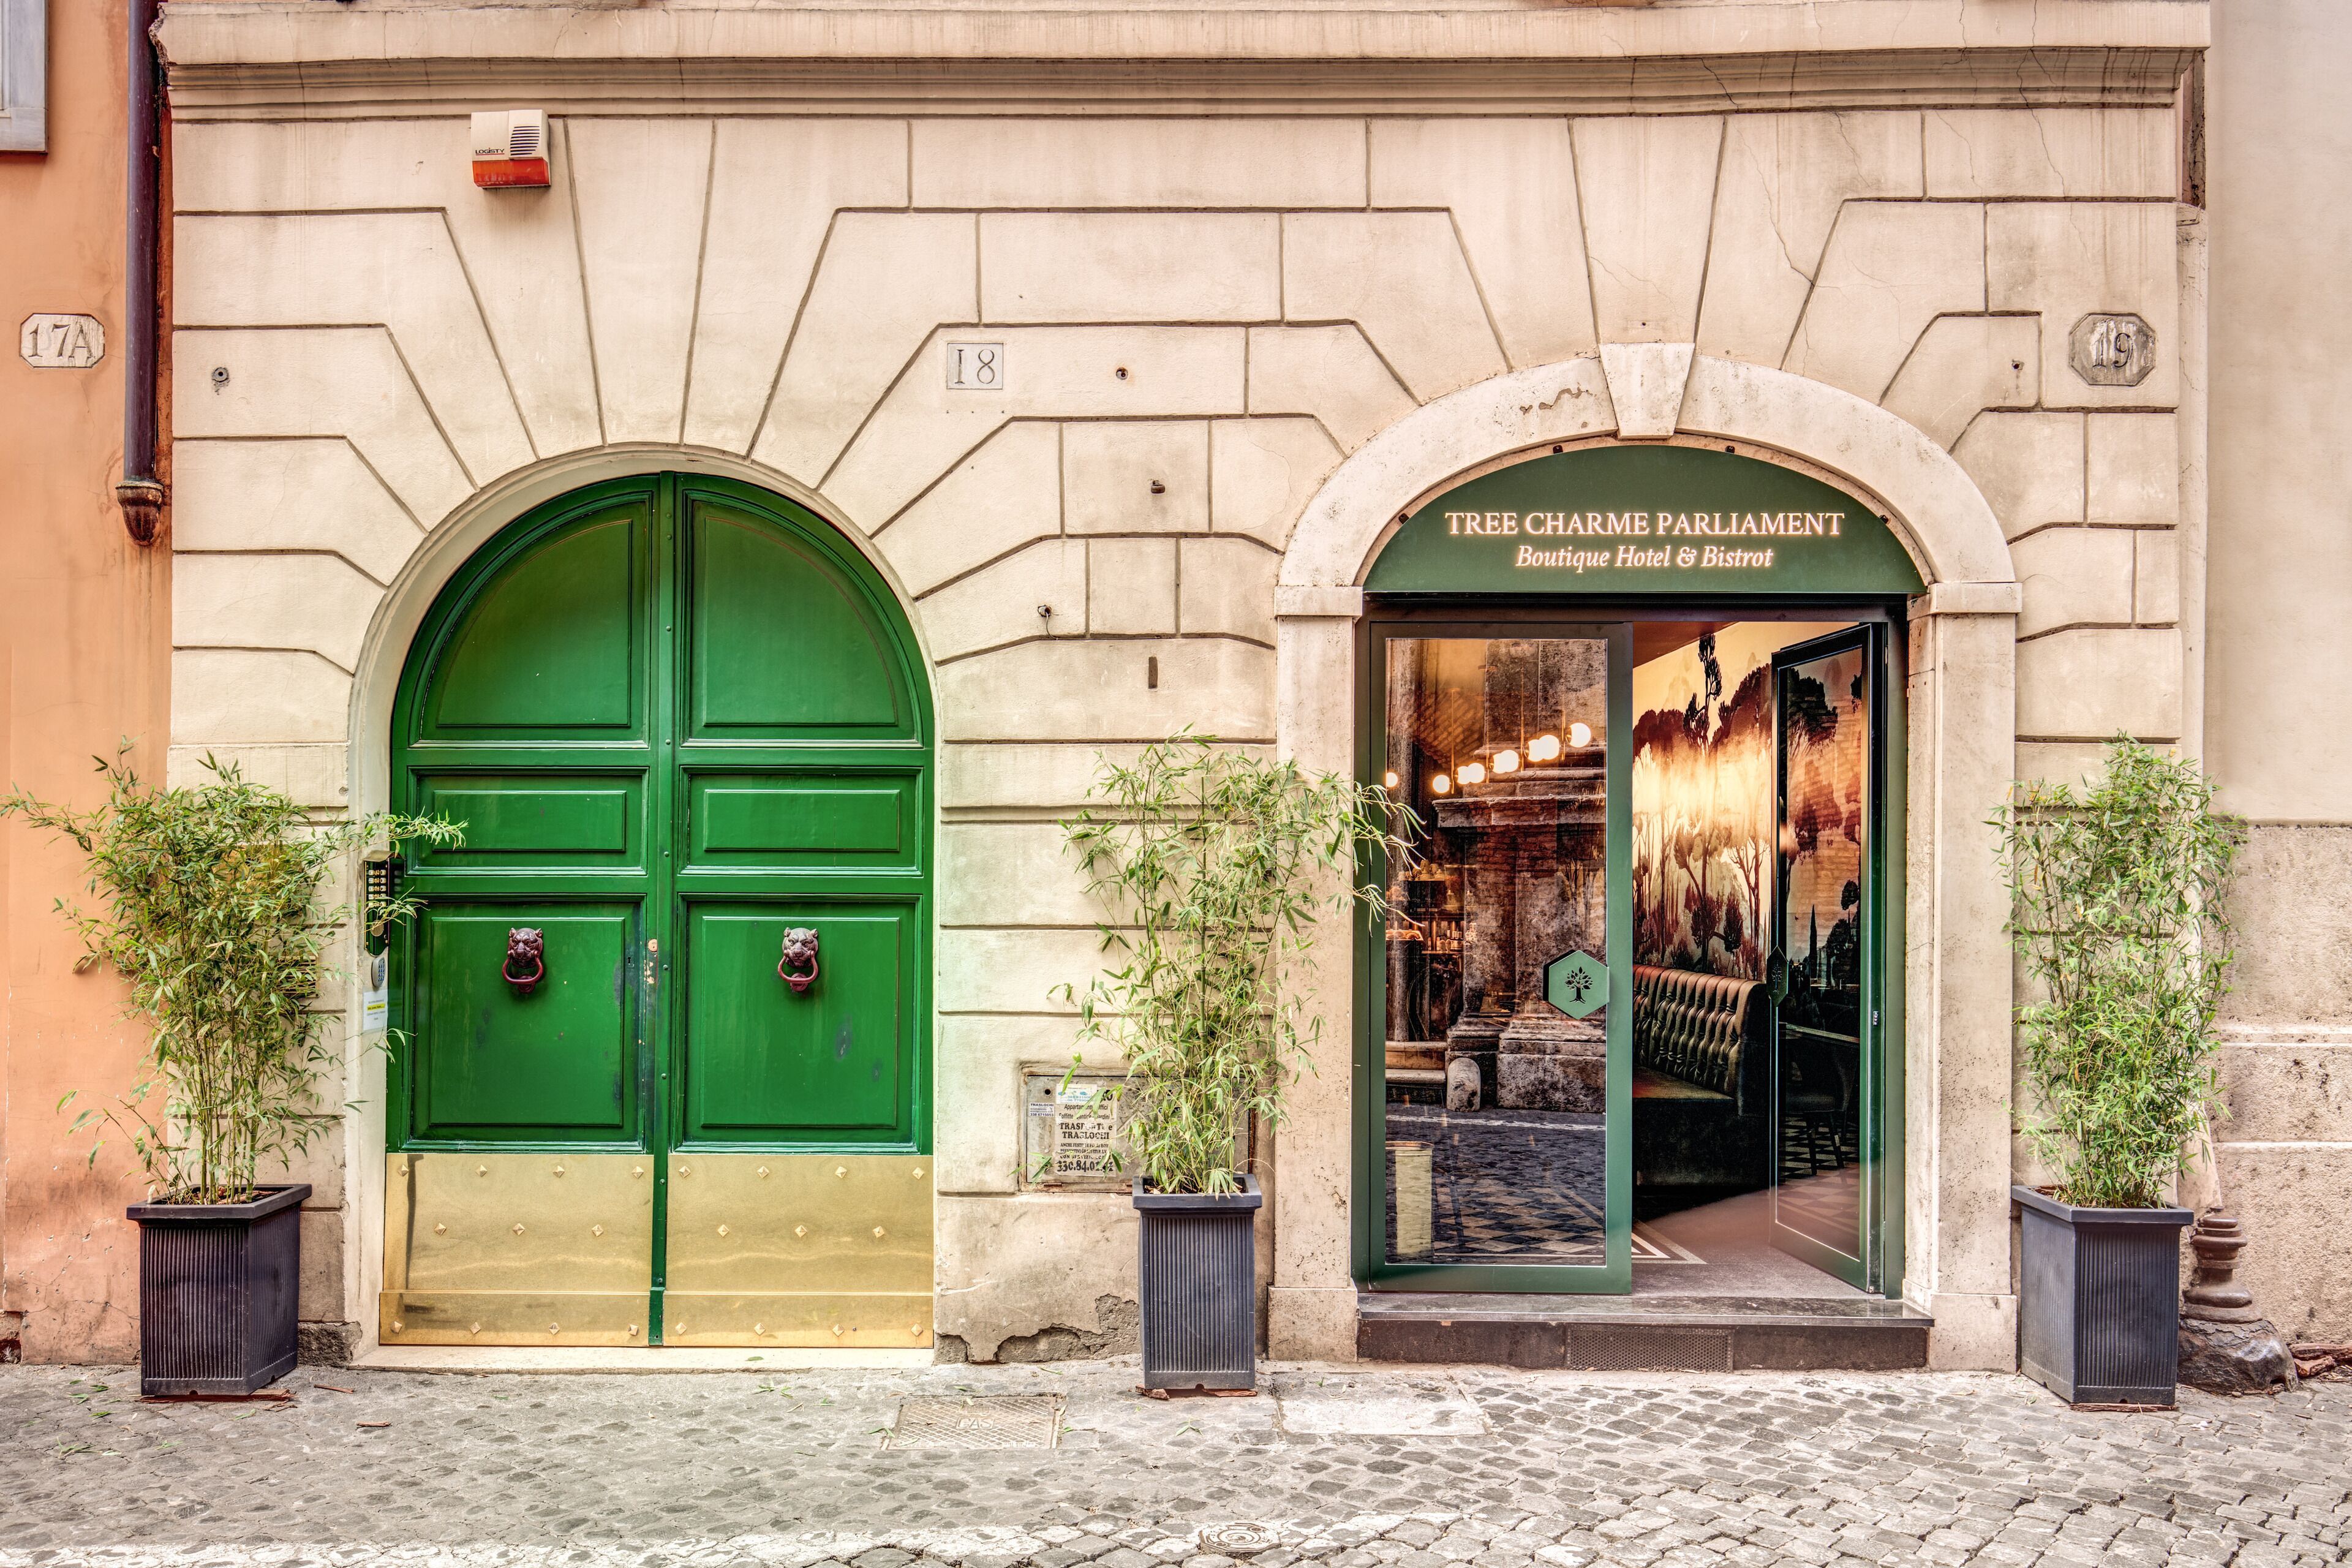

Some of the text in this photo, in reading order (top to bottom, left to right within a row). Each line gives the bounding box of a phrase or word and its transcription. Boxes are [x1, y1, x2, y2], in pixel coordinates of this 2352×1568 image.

[28, 323, 95, 358] 17A
[2092, 333, 2133, 368] 19
[954, 349, 995, 385] 18
[1444, 512, 1845, 535] TREE CHARME PARLIAMENT
[1515, 545, 1773, 573] Boutique Hotel & Bistrot
